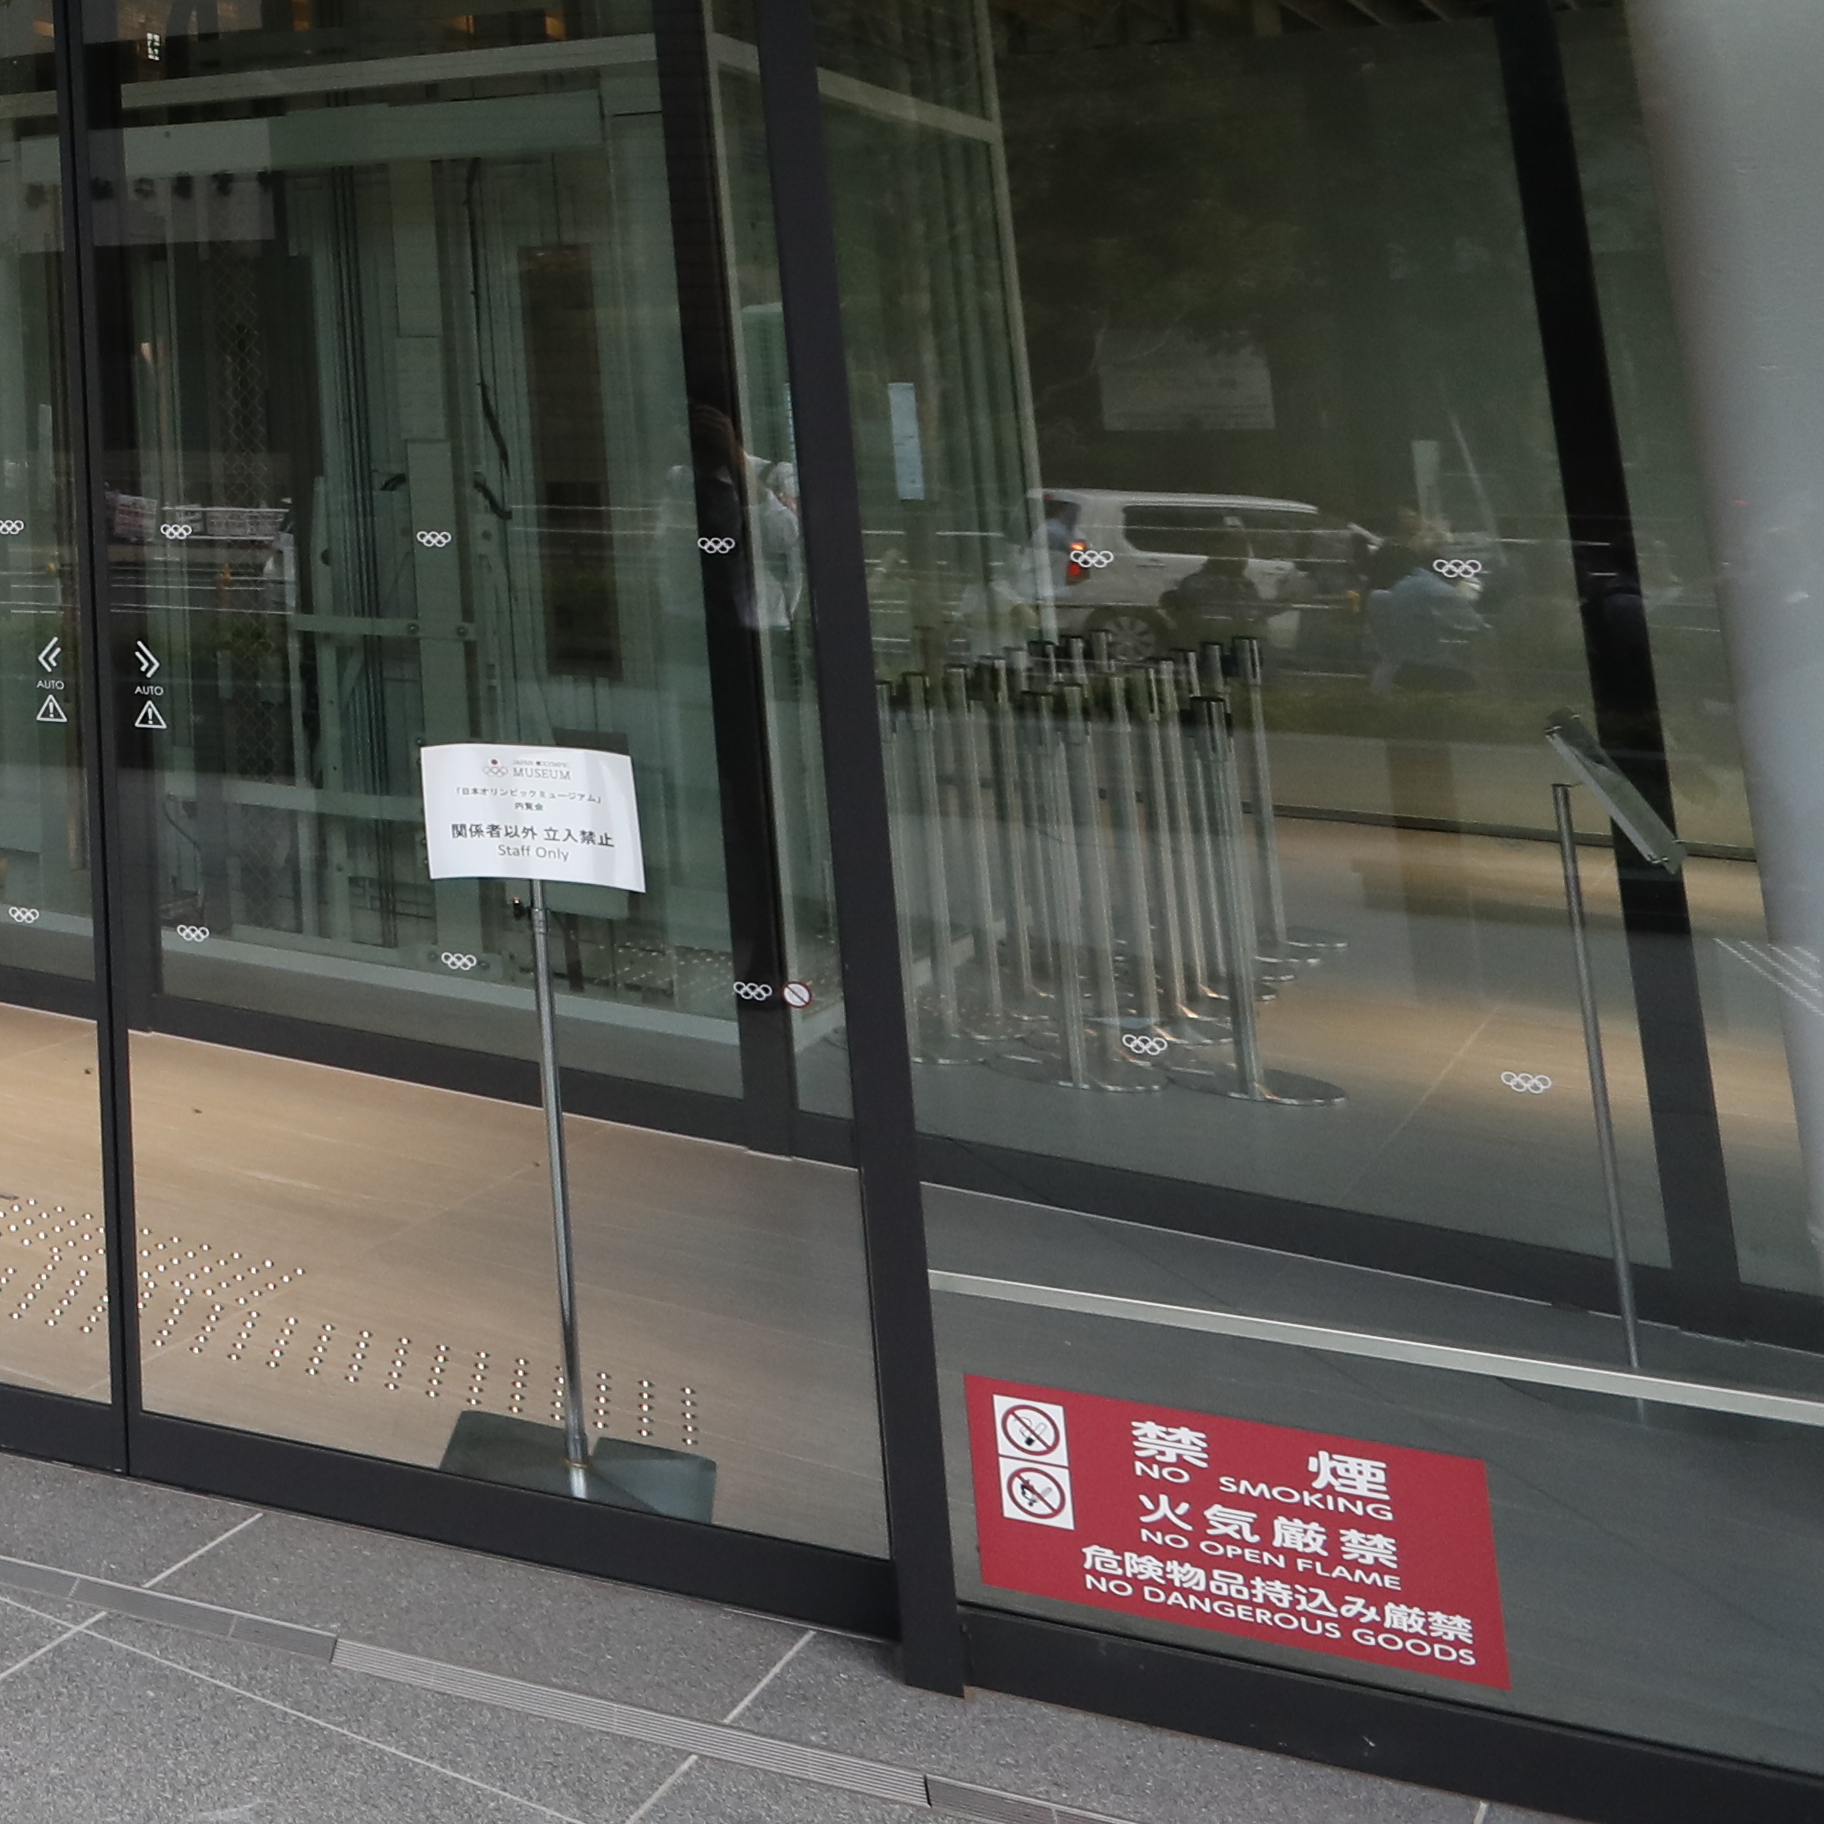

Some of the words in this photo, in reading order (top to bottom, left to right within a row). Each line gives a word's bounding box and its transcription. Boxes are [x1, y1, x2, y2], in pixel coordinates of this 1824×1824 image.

[37, 680, 65, 690] AUTO
[135, 686, 163, 696] AUTO
[513, 767, 572, 780] MUSEUM
[451, 822, 539, 841] 関係者以外
[543, 827, 615, 848] 立入禁止
[498, 844, 531, 858] Staff
[535, 846, 570, 862] Only
[1134, 1461, 1190, 1484] NO
[1219, 1475, 1394, 1522] SMOKING
[1138, 1492, 1399, 1570] 火気厳禁
[1140, 1529, 1188, 1549] NO
[1199, 1538, 1285, 1569] OPEN
[1296, 1558, 1402, 1591] FLAME
[1082, 1544, 1474, 1645] 危険物品持込み厳禁
[1085, 1574, 1133, 1598] NO
[1142, 1585, 1342, 1640] DANGEROUS
[1352, 1628, 1477, 1666] GOODS
